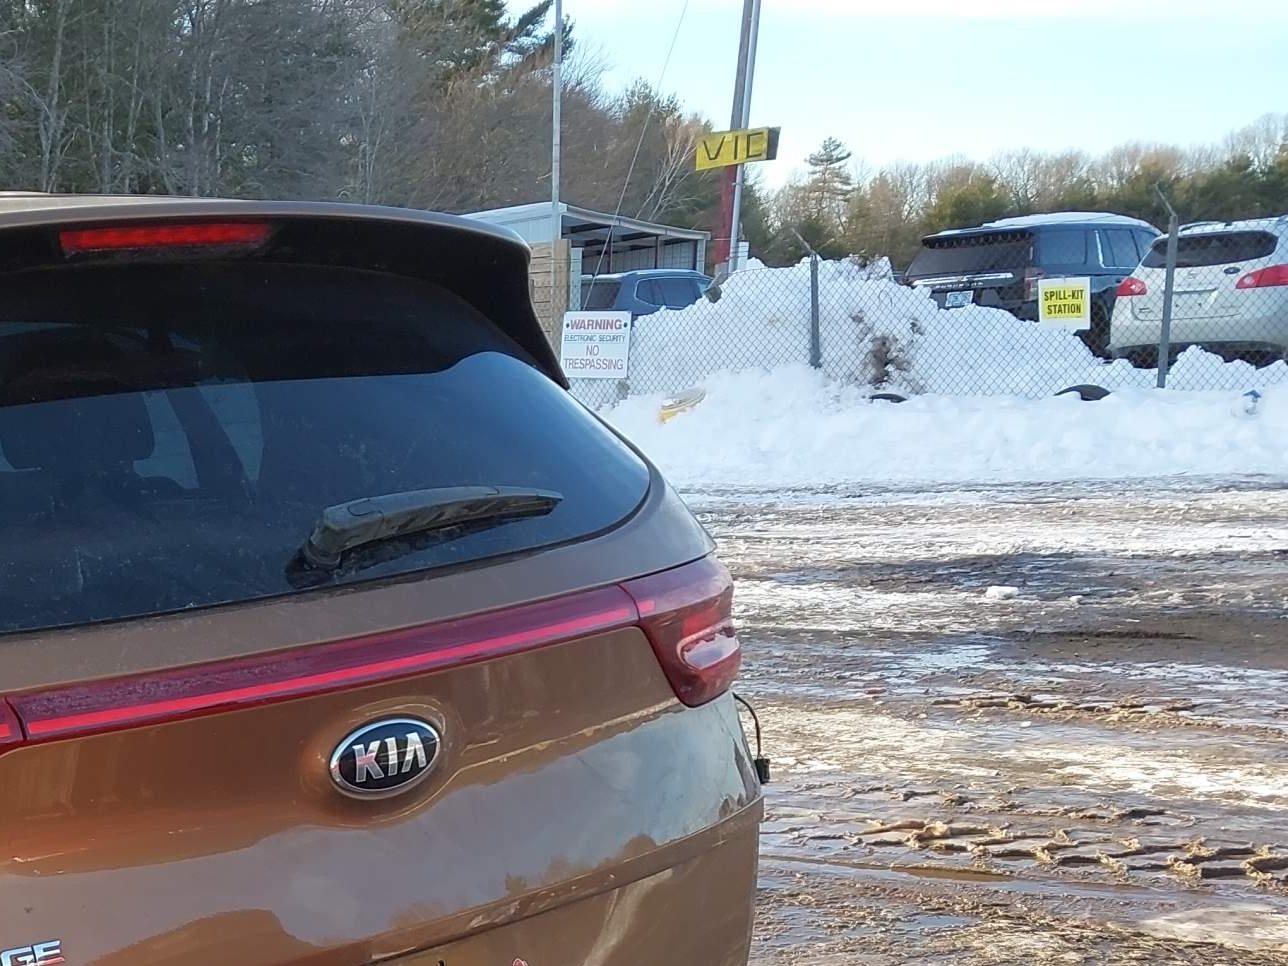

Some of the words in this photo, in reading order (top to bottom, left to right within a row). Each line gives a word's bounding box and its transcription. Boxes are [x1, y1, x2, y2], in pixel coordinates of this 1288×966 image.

[1043, 289, 1084, 301] SPILL-KIT
[1047, 303, 1081, 315] STATION
[570, 319, 622, 330] WARNING
[564, 334, 597, 342] ELECTRONIC
[598, 334, 626, 342] SECURITY
[585, 345, 600, 356] NO
[563, 358, 624, 370] TRESPASSING
[352, 731, 427, 783] KIA
